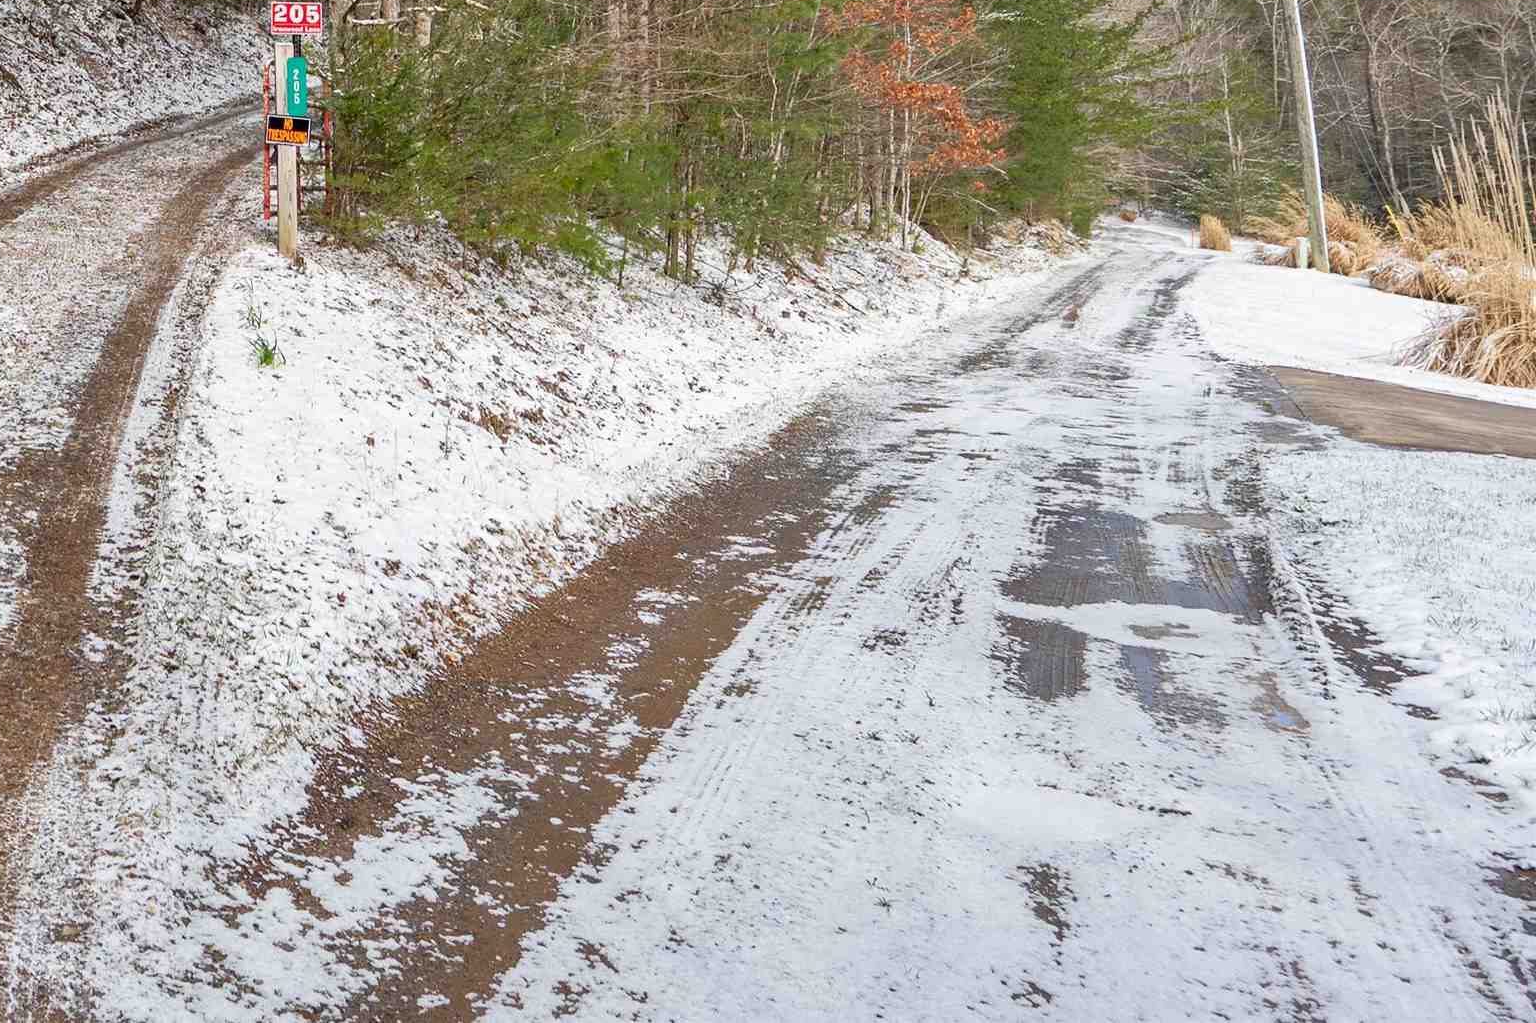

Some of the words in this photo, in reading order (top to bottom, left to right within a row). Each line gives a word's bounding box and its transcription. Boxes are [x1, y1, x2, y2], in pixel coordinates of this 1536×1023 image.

[274, 5, 320, 24] 205
[283, 117, 294, 130] NO
[267, 129, 308, 145] TRESPASSING
